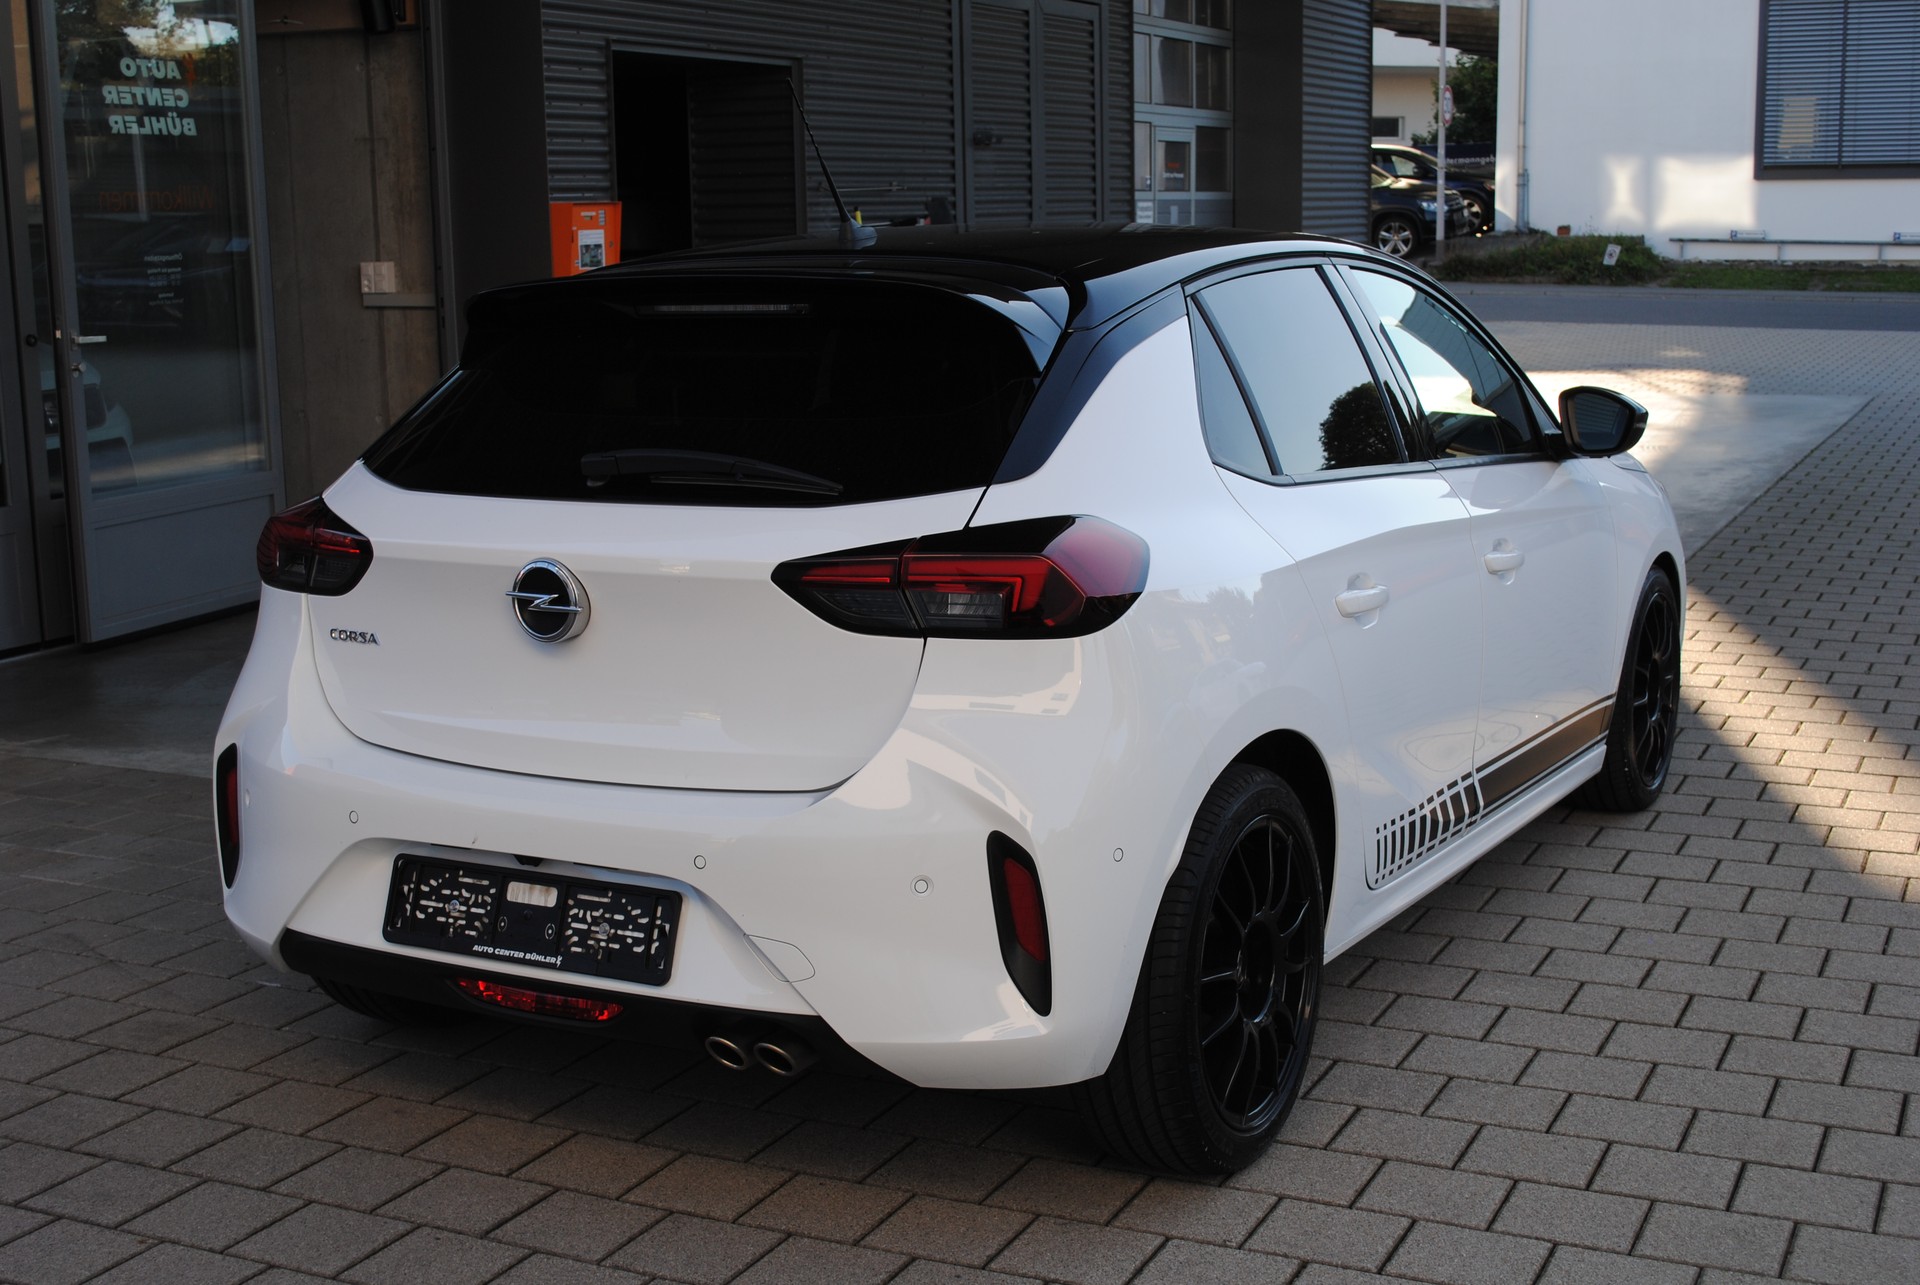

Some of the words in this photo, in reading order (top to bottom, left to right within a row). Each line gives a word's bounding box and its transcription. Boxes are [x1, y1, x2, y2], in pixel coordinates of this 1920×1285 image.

[330, 628, 380, 646] CORSA
[472, 945, 494, 954] AUTO
[494, 948, 525, 959] CENTER
[525, 952, 557, 964] BÜHLER
